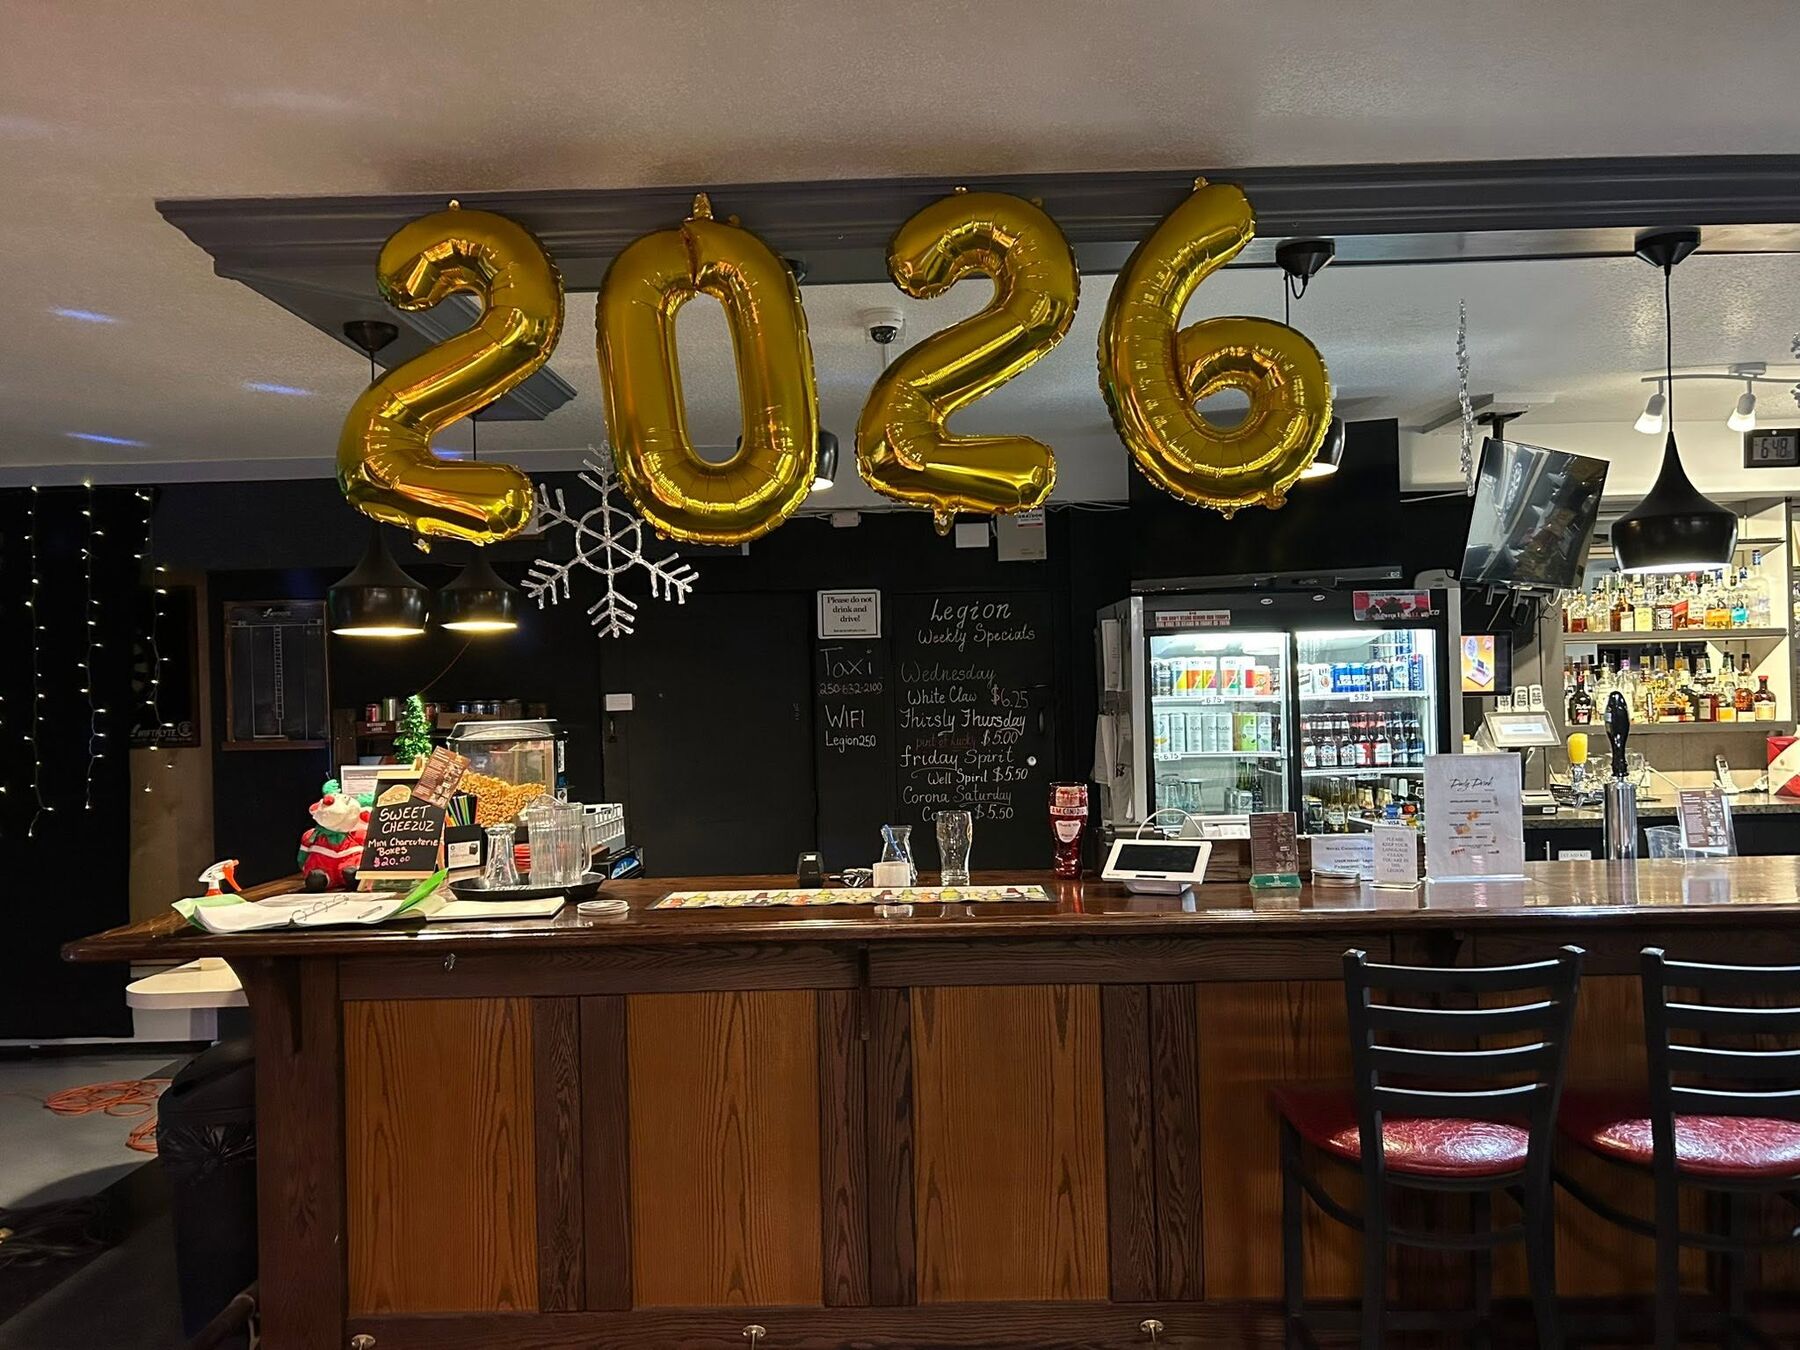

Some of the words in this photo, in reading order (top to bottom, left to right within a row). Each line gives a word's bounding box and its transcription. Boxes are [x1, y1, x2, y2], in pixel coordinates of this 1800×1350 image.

[930, 598, 1012, 629] Legion
[918, 627, 967, 652] Weekly
[973, 622, 1035, 648] Specials
[819, 647, 873, 678] Taxi
[900, 660, 996, 688] Wednesday
[907, 687, 945, 705] White
[949, 685, 977, 703] Claw
[990, 684, 1029, 708] $6.25
[825, 704, 865, 729] WIFI
[961, 708, 1026, 736] Thursday
[825, 730, 877, 753] Legion250
[980, 729, 1018, 747] $5.00
[963, 746, 1015, 769] Spirit
[927, 771, 952, 785] Well
[992, 766, 1029, 783] $5.50
[902, 785, 949, 804] Corona
[952, 783, 1012, 806] Saturday
[379, 805, 431, 821] SWEET
[382, 820, 434, 834] CHEEZUZ
[377, 847, 408, 857] Boxes
[390, 837, 439, 846] Charcuterie
[373, 855, 410, 867] $20.00
